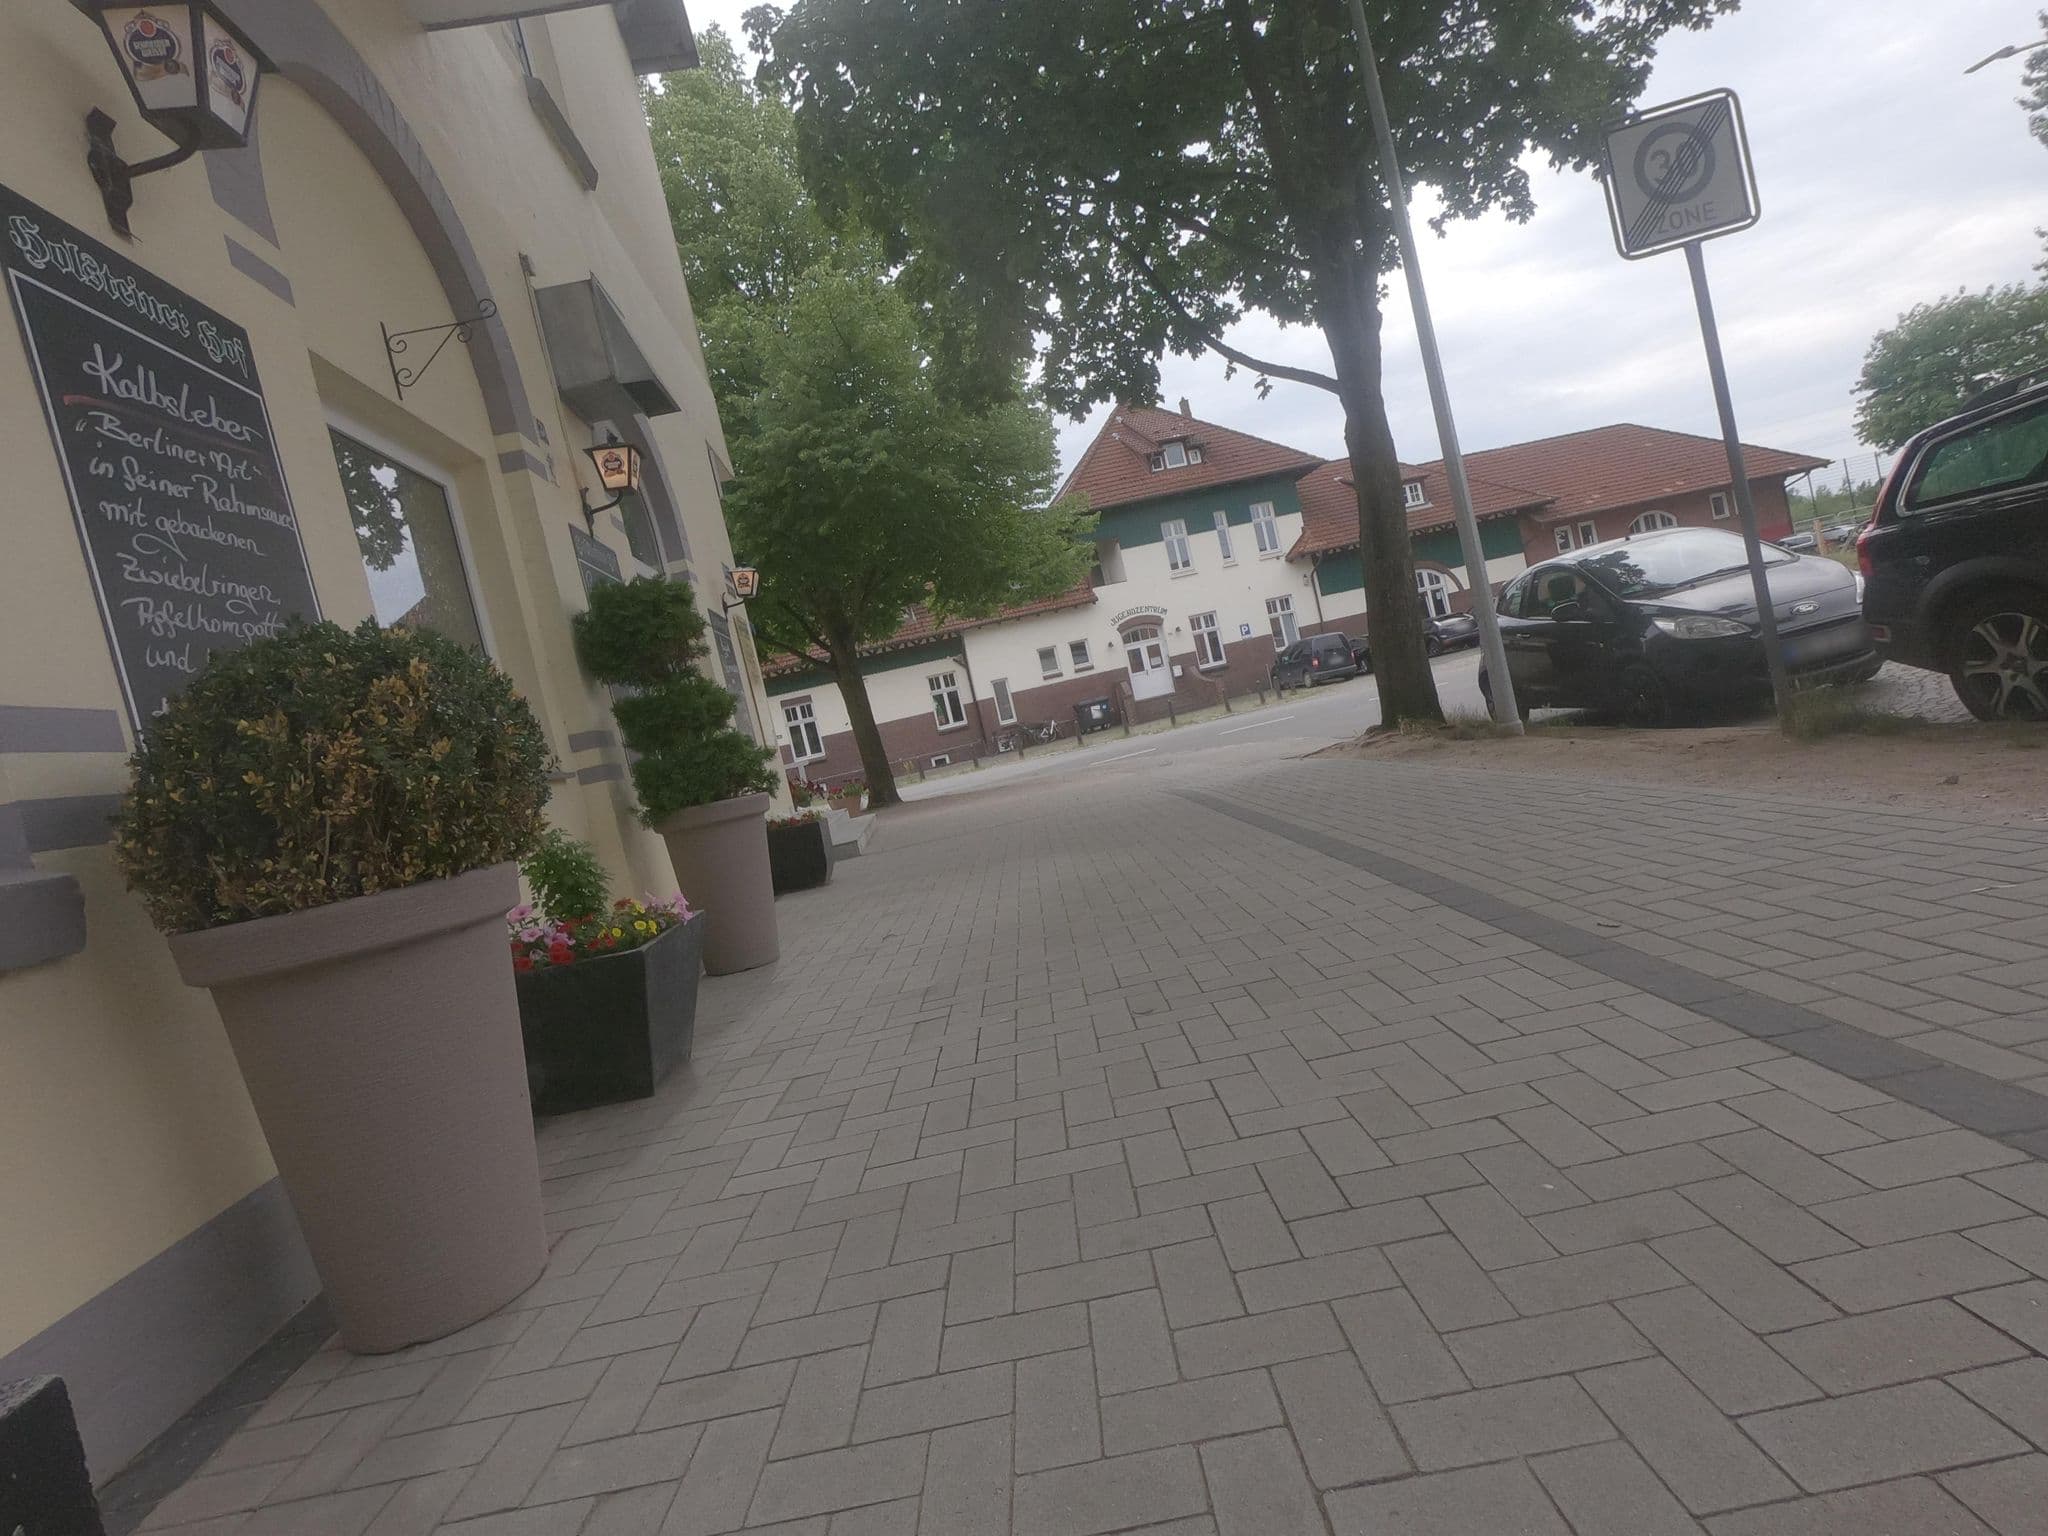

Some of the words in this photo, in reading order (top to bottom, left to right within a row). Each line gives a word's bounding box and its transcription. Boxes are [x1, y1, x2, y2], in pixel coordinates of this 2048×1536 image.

[1656, 201, 1717, 234] ZONE
[8, 215, 190, 338] Holsteiner
[196, 320, 249, 380] Hof
[82, 342, 264, 442] Kalbsleber
[89, 440, 115, 478] in
[99, 496, 148, 528] mit
[132, 508, 268, 563] gebackenen
[121, 596, 288, 647] Apfelkompott
[1110, 605, 1168, 627] JUGENDZENTRUM
[146, 643, 198, 674] und
